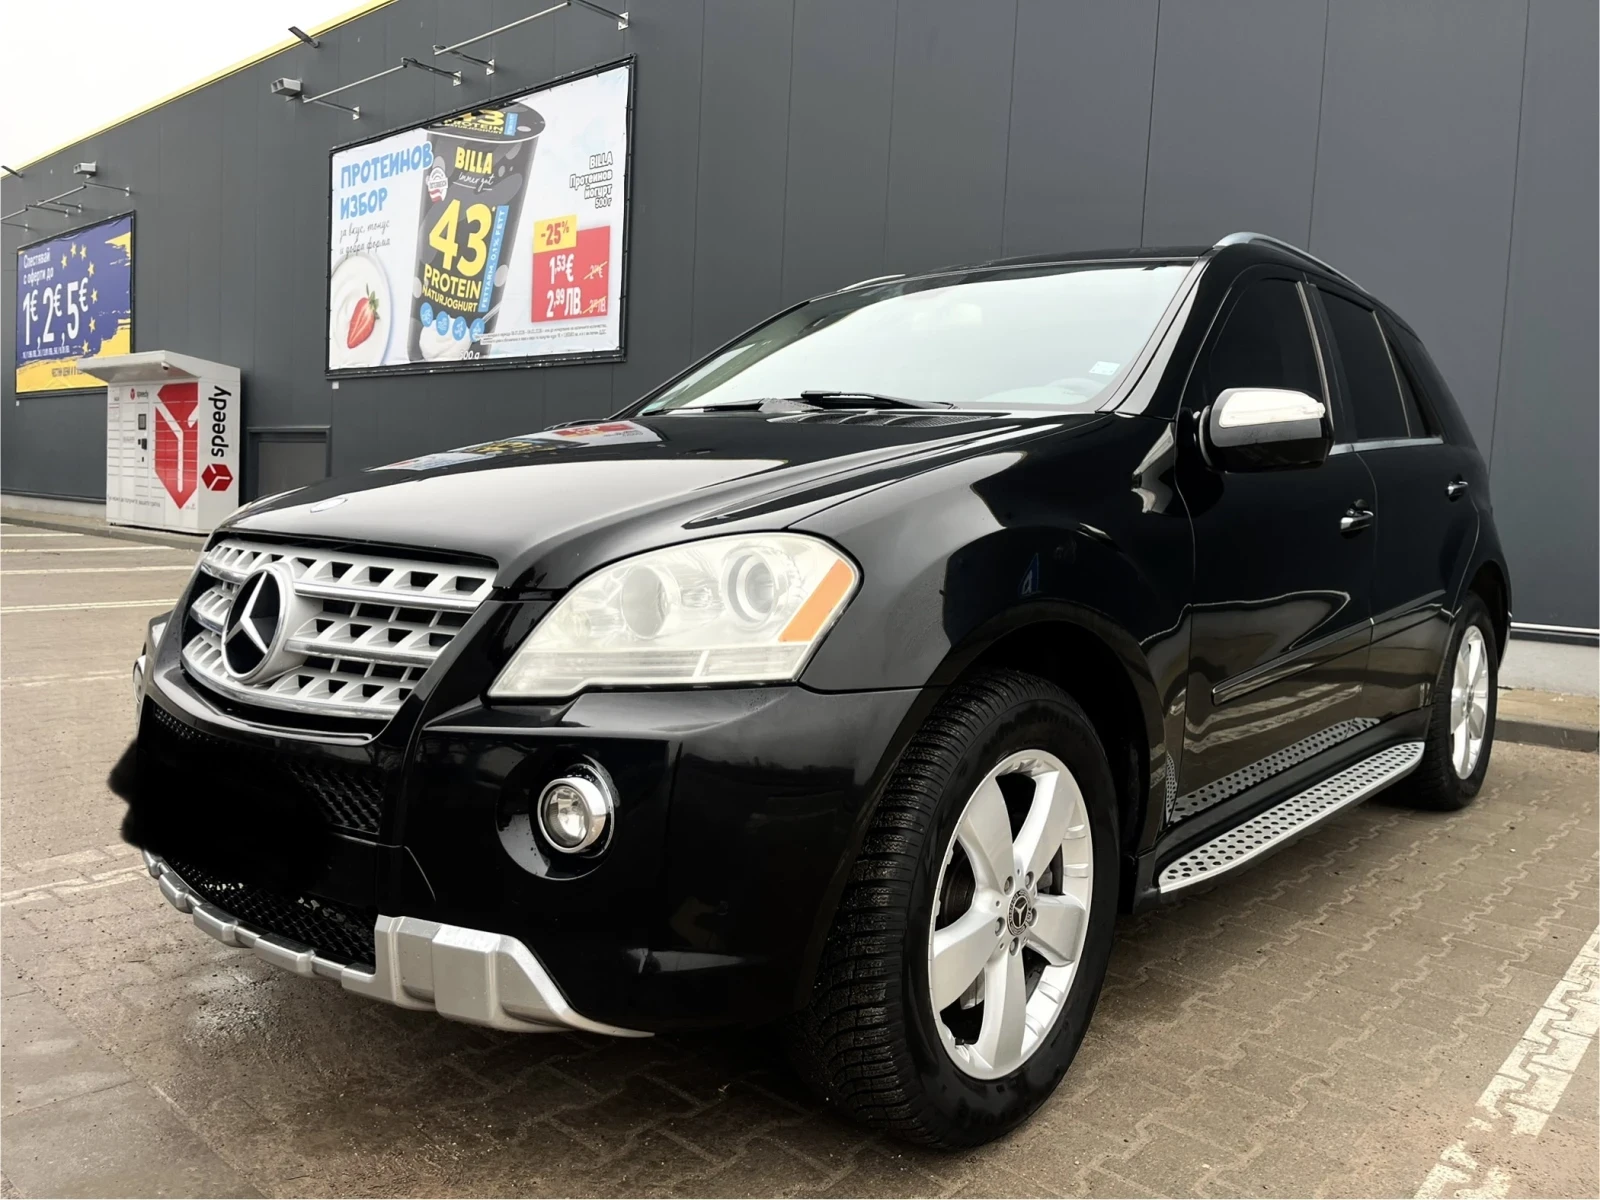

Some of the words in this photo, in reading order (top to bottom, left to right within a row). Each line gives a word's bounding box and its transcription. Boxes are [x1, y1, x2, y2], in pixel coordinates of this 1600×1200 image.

[341, 142, 433, 189] ПРОТЕИНОВ
[455, 146, 493, 174] BILLA
[589, 151, 613, 169] BILLA
[569, 170, 613, 191] Протеинов
[584, 184, 613, 200] йогурт
[341, 187, 388, 220] ИЗБОР
[495, 210, 506, 236] FETT
[541, 220, 570, 246] -25%
[423, 263, 482, 299] PROTEIN
[422, 286, 478, 313] NATURJOGHURT
[208, 385, 232, 457] speedy
